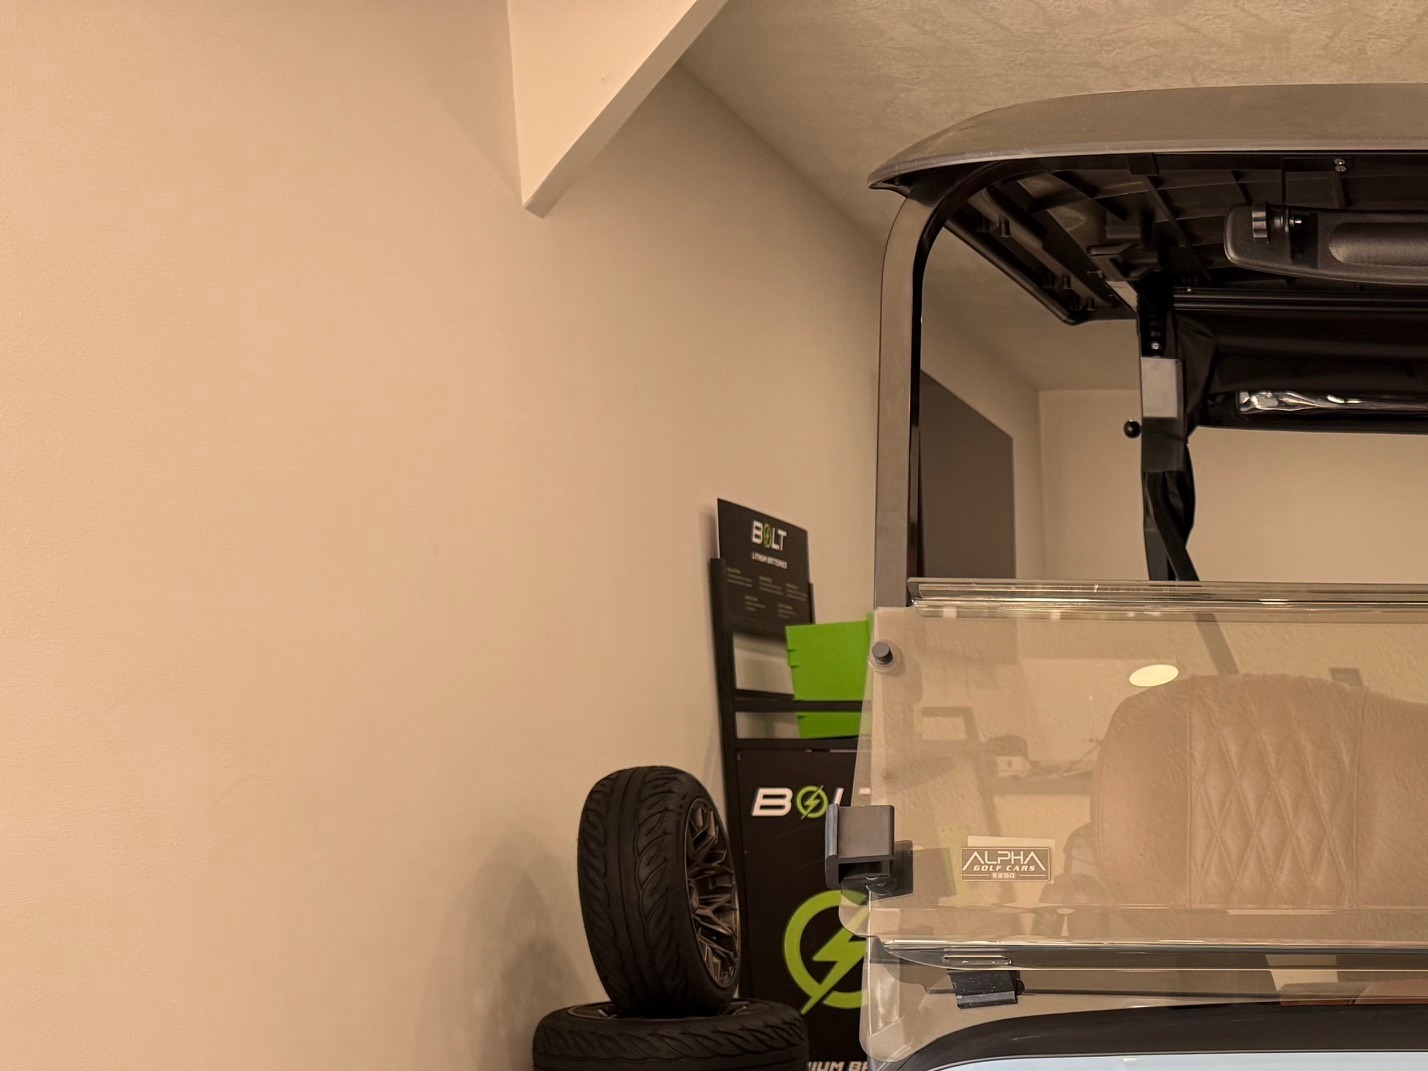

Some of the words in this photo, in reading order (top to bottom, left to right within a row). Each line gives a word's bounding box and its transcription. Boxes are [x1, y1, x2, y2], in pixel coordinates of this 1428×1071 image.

[752, 520, 787, 551] BOLT
[962, 850, 1046, 871] ALPHA
[973, 864, 1003, 872] GOLF
[1005, 864, 1036, 872] CARS
